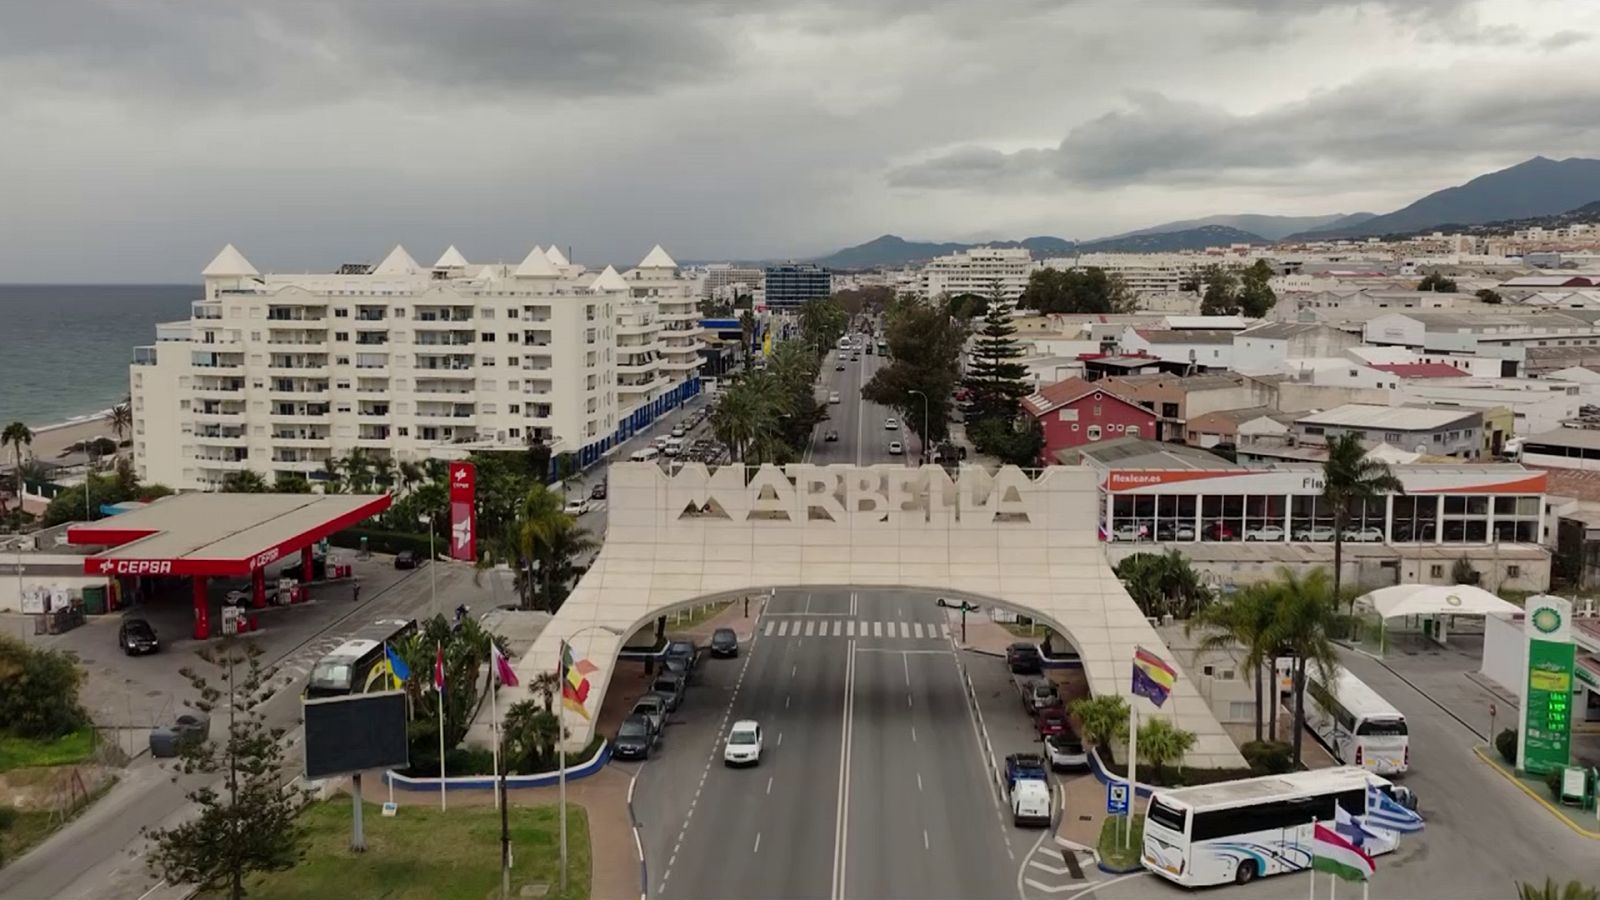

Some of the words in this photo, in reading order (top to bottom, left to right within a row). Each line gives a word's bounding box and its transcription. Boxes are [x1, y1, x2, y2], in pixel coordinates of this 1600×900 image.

[1112, 474, 1162, 483] flexicar.es
[664, 464, 1045, 522] MARBELLA
[117, 561, 171, 573] CEPSA
